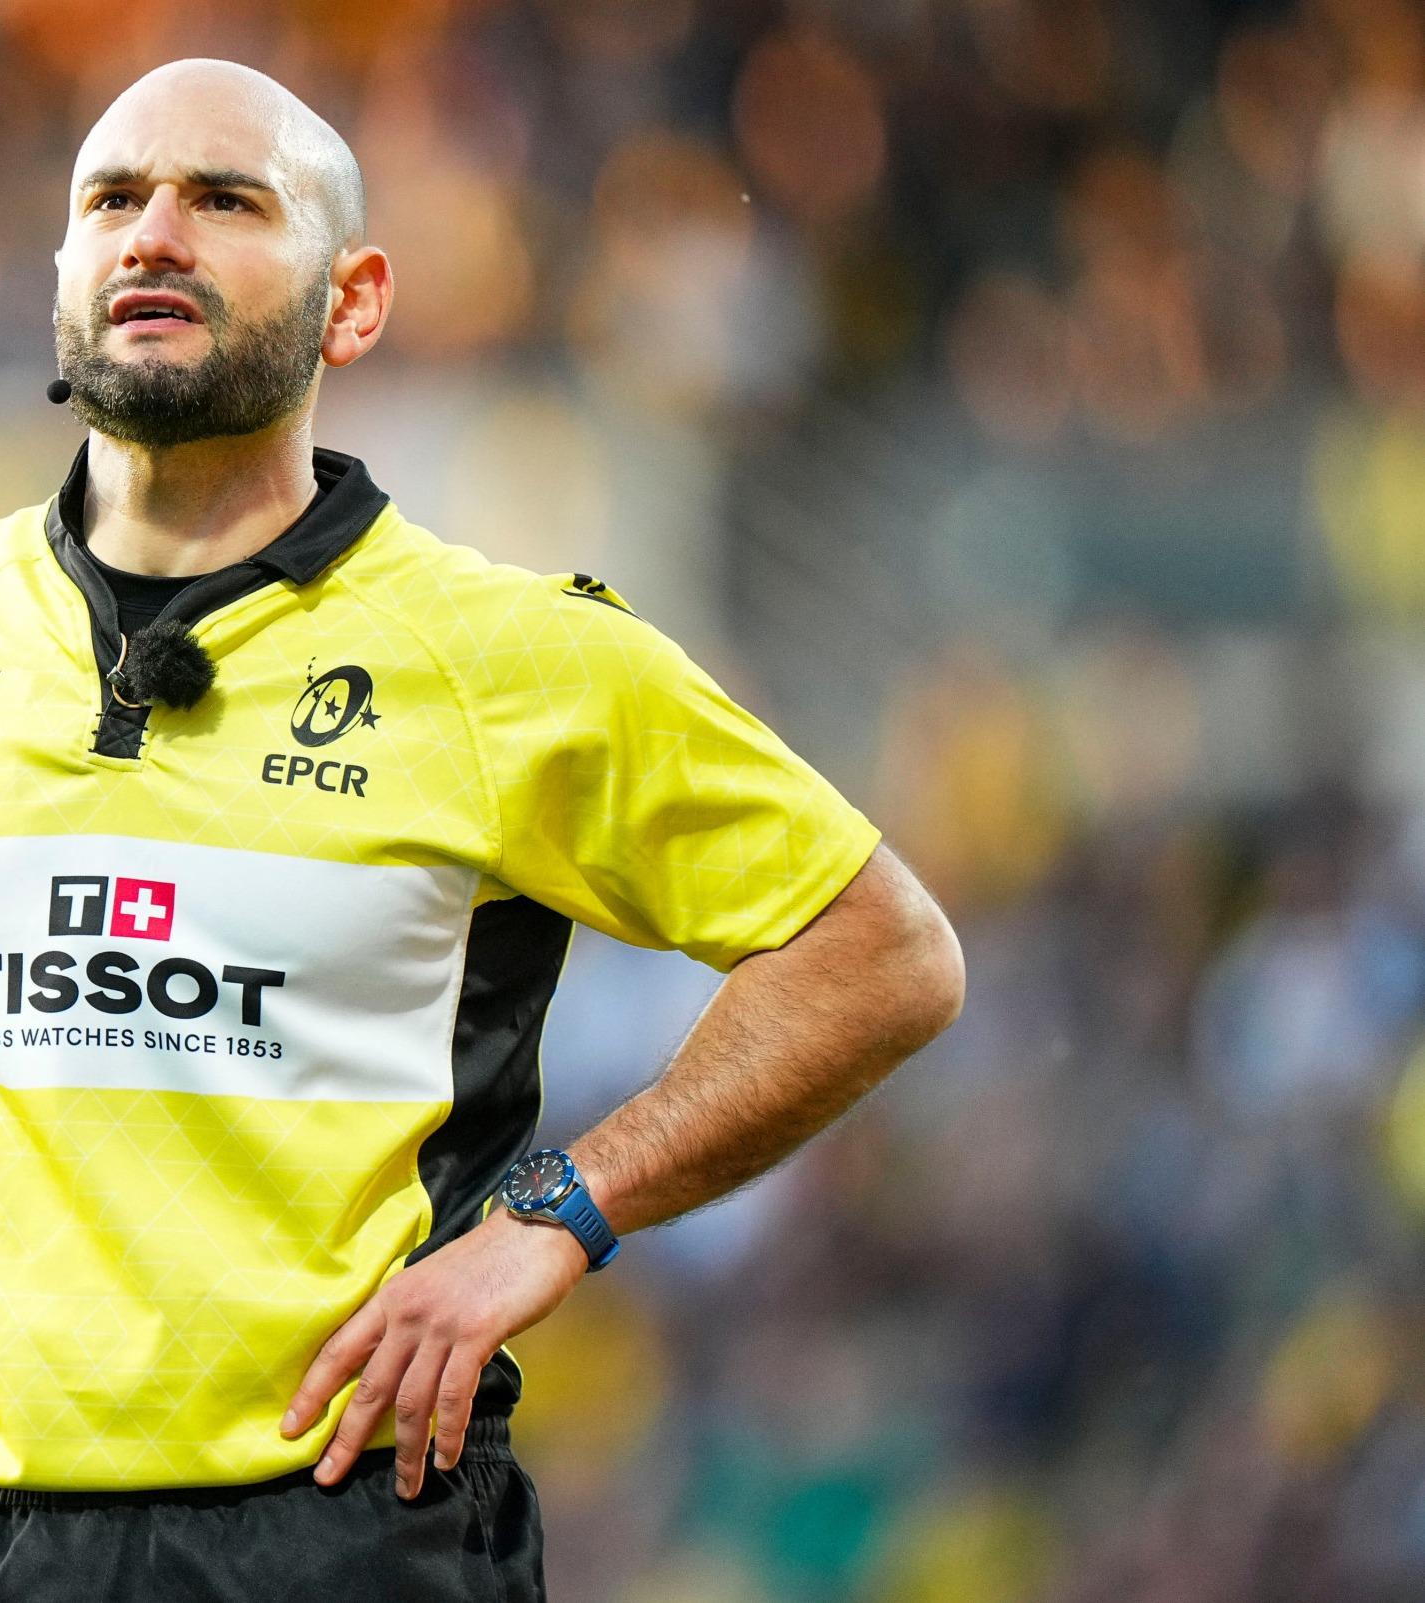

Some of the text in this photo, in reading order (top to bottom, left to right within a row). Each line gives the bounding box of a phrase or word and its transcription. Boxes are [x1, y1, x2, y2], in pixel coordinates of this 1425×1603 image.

[261, 753, 369, 798] EPCR
[56, 881, 103, 930] T
[21, 1027, 135, 1047] WATCHES
[144, 1030, 216, 1053] SINCE
[226, 1037, 282, 1059] 1853
